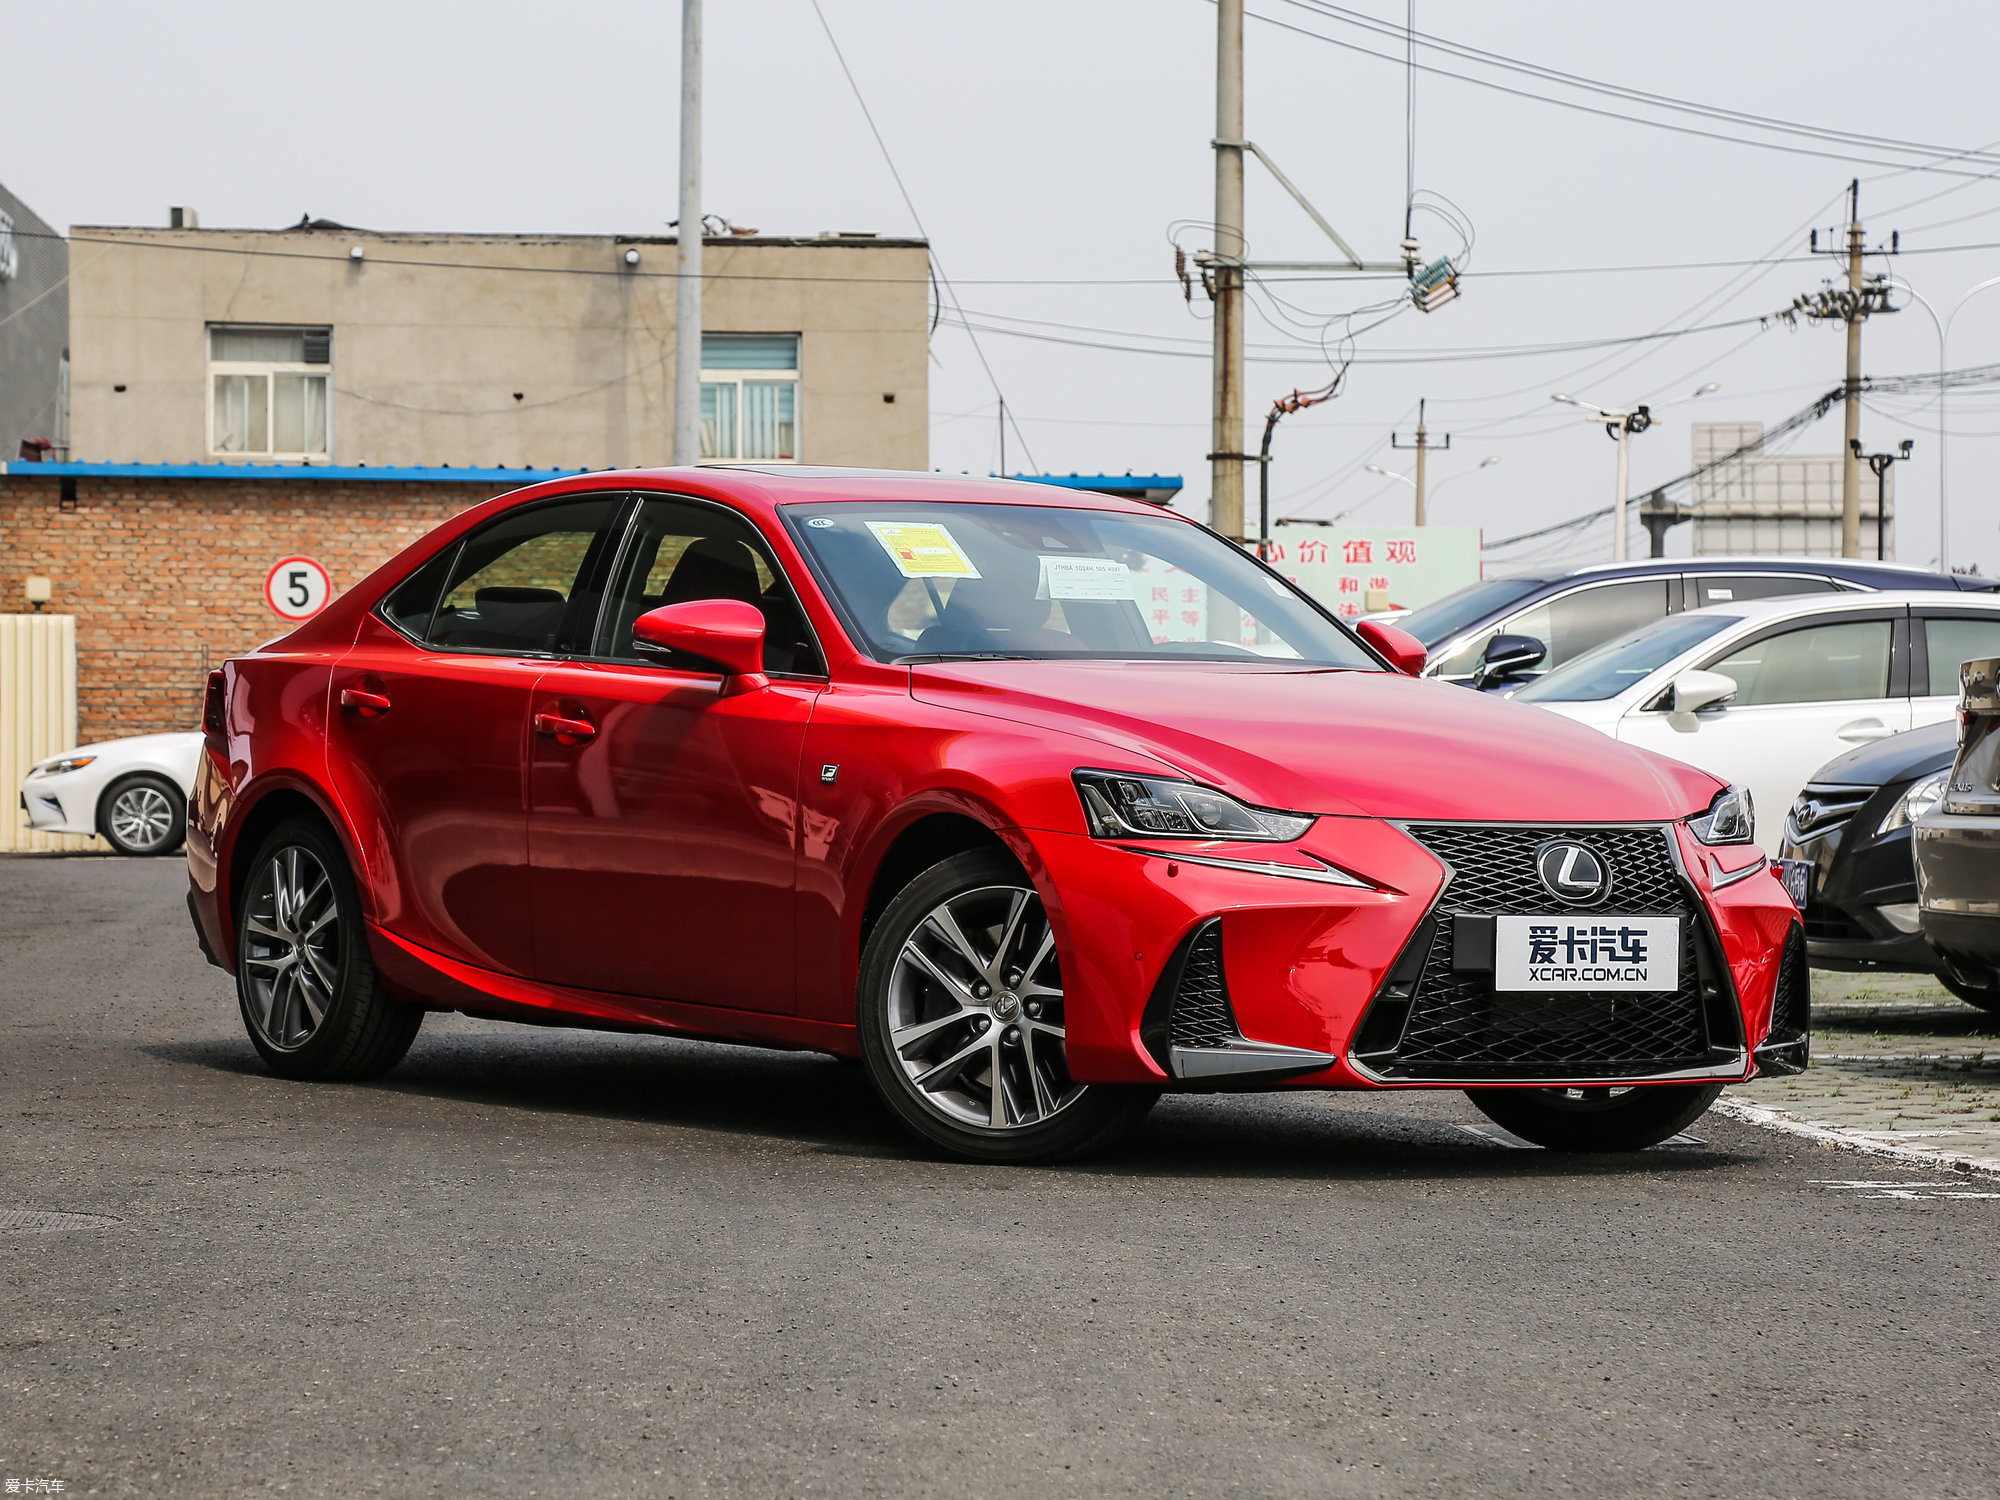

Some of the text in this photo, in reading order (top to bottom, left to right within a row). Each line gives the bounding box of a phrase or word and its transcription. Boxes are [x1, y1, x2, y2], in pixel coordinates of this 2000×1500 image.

[288, 571, 309, 608] 5
[1151, 586, 1201, 603] 民主
[1151, 608, 1201, 628] 平等
[1529, 925, 1648, 965] 爱卡汽车
[1528, 967, 1648, 983] XCAR.COM.CN
